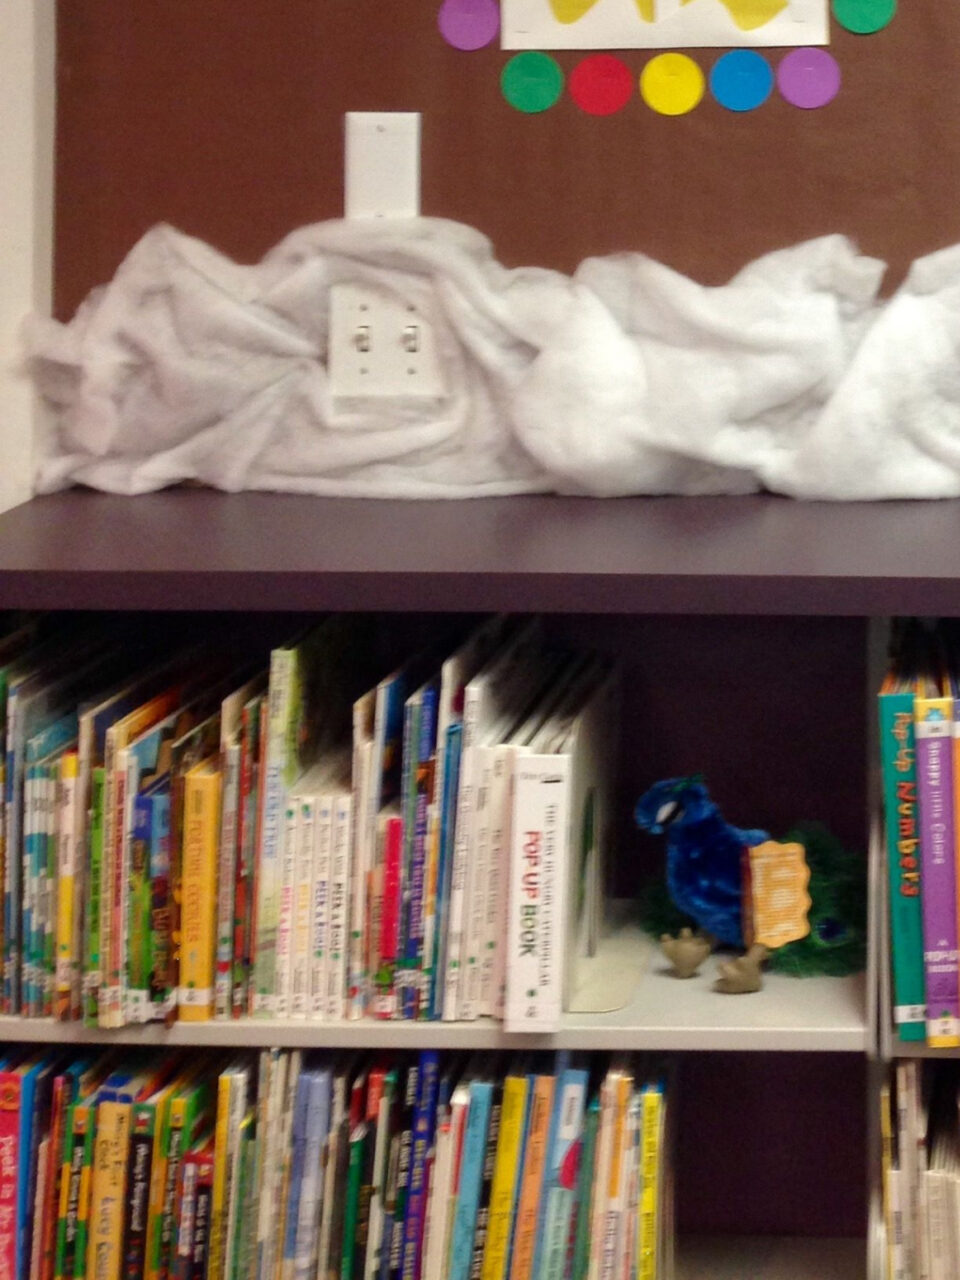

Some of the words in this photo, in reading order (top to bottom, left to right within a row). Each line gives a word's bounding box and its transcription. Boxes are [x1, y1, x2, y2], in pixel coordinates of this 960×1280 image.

[927, 741, 942, 786] Snappy
[895, 781, 921, 897] Numbers
[932, 823, 946, 865] Colors
[518, 904, 538, 957] BOOK
[98, 1197, 115, 1235] Lucy
